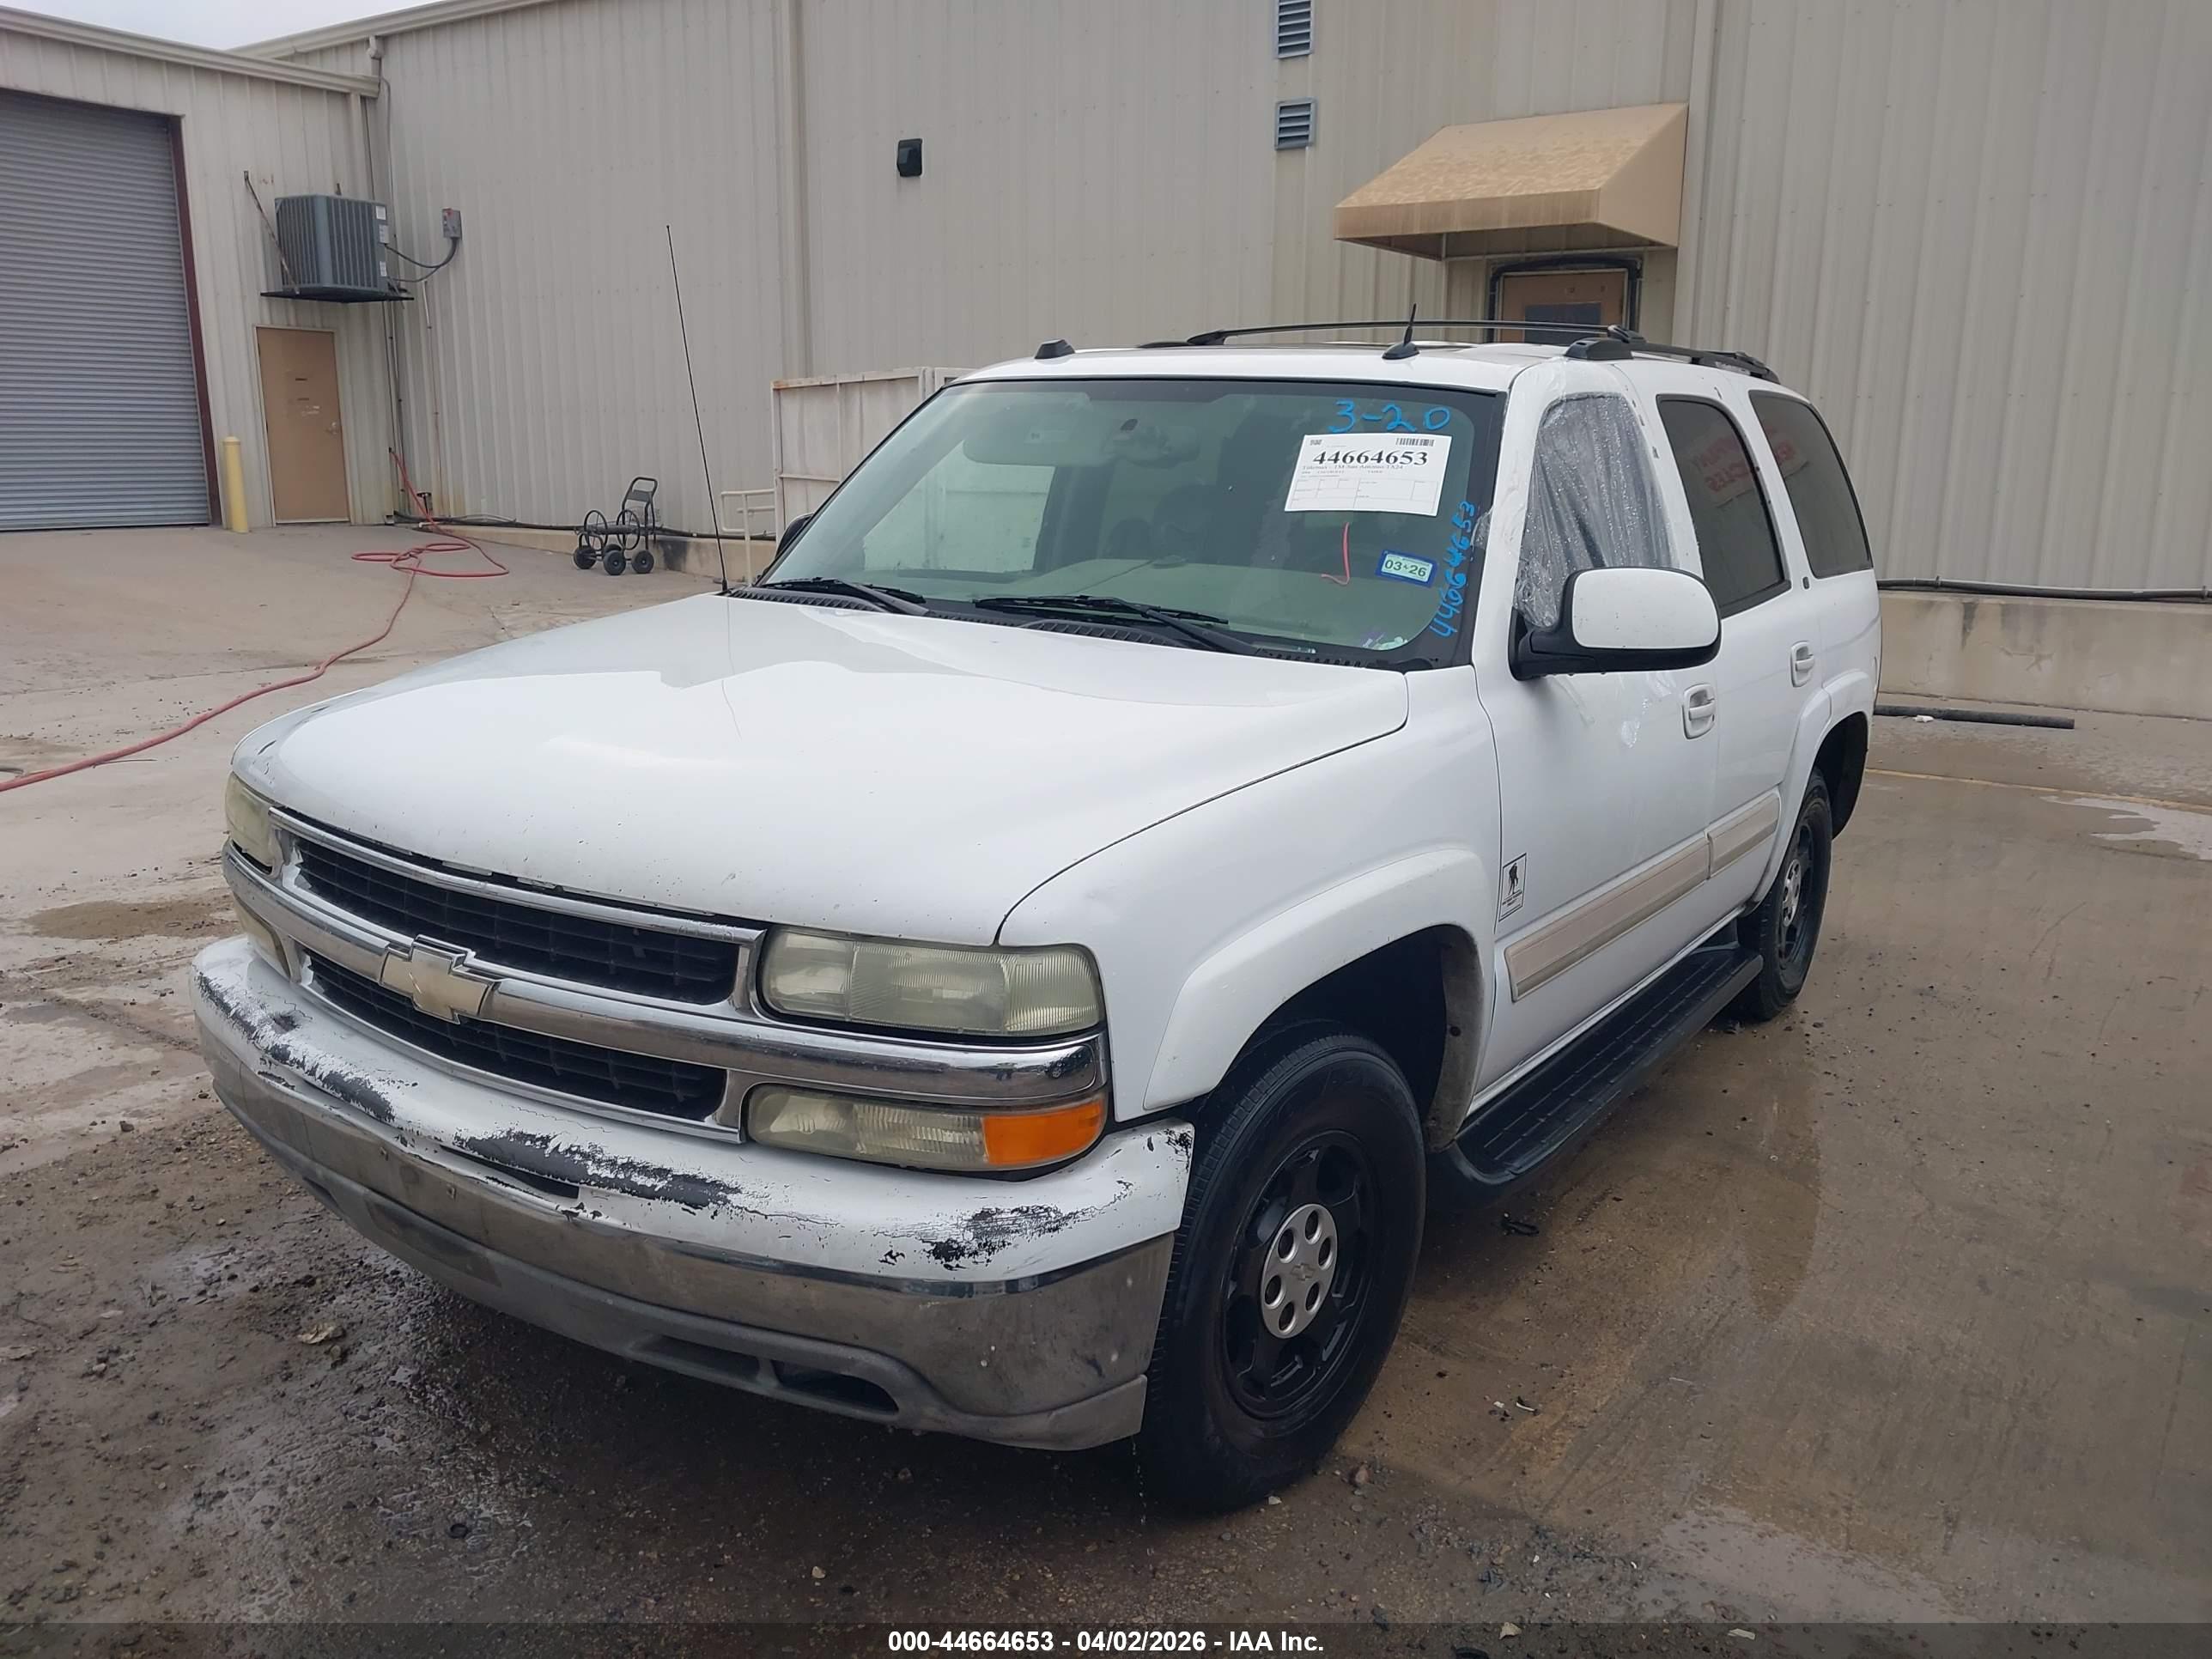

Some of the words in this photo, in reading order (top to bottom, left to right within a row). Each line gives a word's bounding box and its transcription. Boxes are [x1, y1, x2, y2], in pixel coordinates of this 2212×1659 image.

[1328, 398, 1450, 433] 3-20
[1313, 450, 1428, 465] 44664653
[1429, 501, 1475, 637] 44664653
